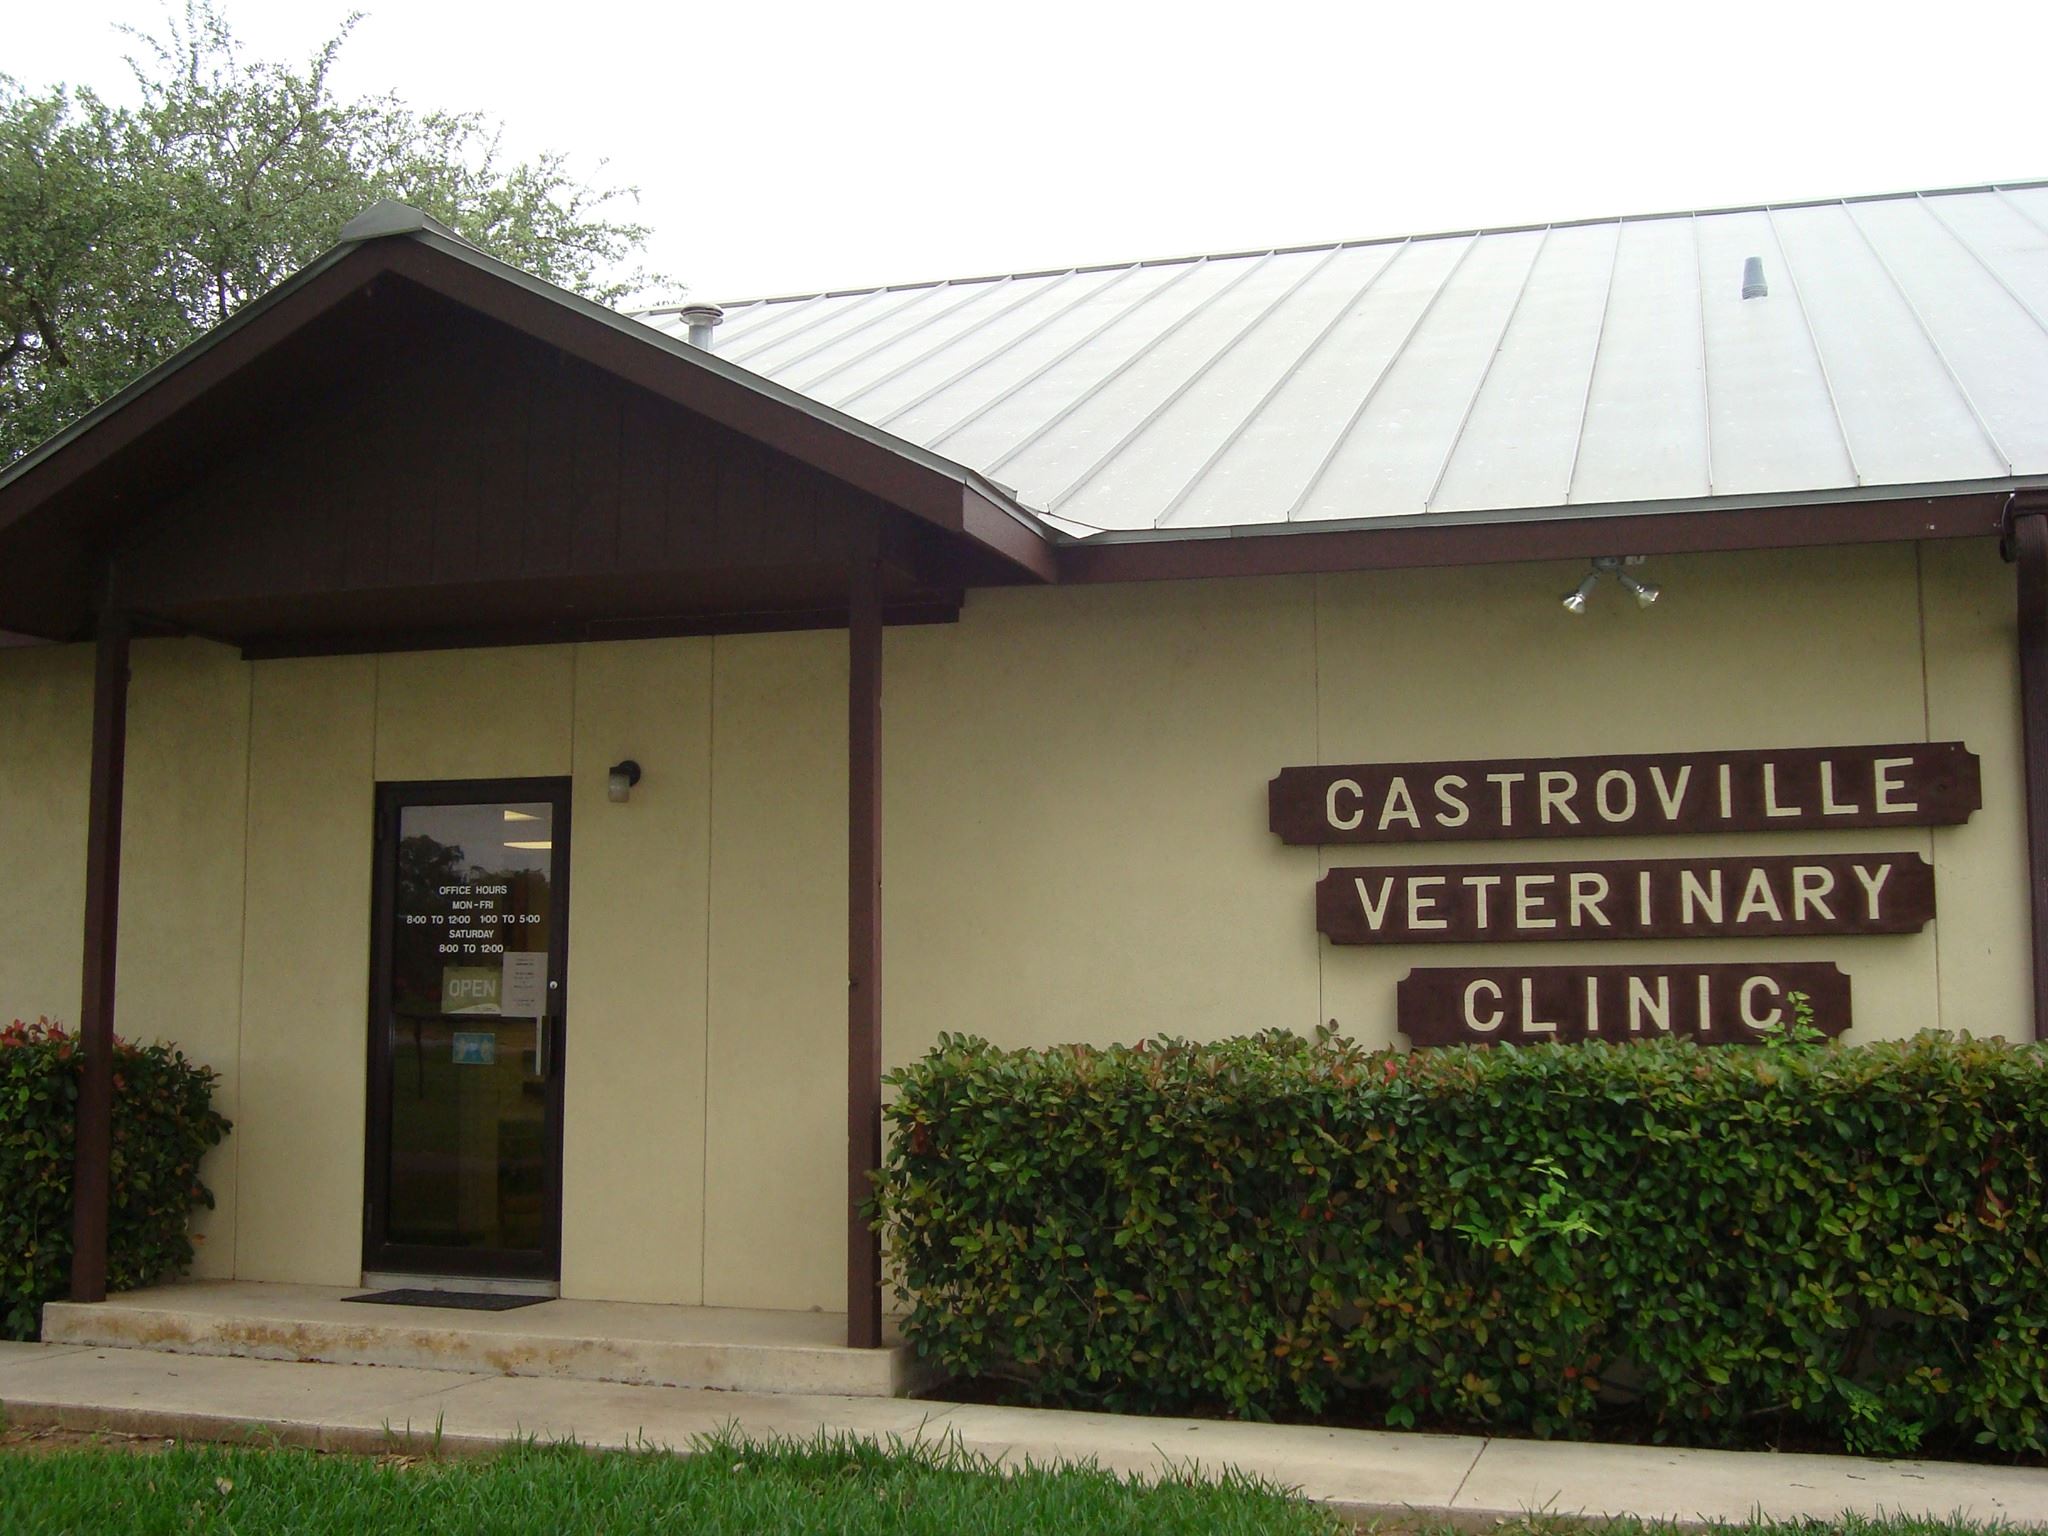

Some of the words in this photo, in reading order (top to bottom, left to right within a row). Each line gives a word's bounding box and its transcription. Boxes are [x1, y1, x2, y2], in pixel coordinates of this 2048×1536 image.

[1325, 757, 1918, 831] CASTROVILLE
[439, 885, 471, 895] OFFICE
[475, 885, 508, 895] HOURS
[1354, 863, 1892, 930] VETERINARY
[406, 915, 427, 924] 8:00
[431, 915, 444, 924] TO
[448, 915, 471, 924] 12:00
[480, 914, 498, 924] 1:00
[502, 914, 516, 924] TO
[519, 914, 541, 924] 5:00
[448, 929, 495, 939] SATURDAY
[463, 943, 477, 953] TO
[480, 943, 504, 952] 12:00
[448, 979, 496, 997] OPEN
[1463, 974, 1783, 1033] CLINIC
